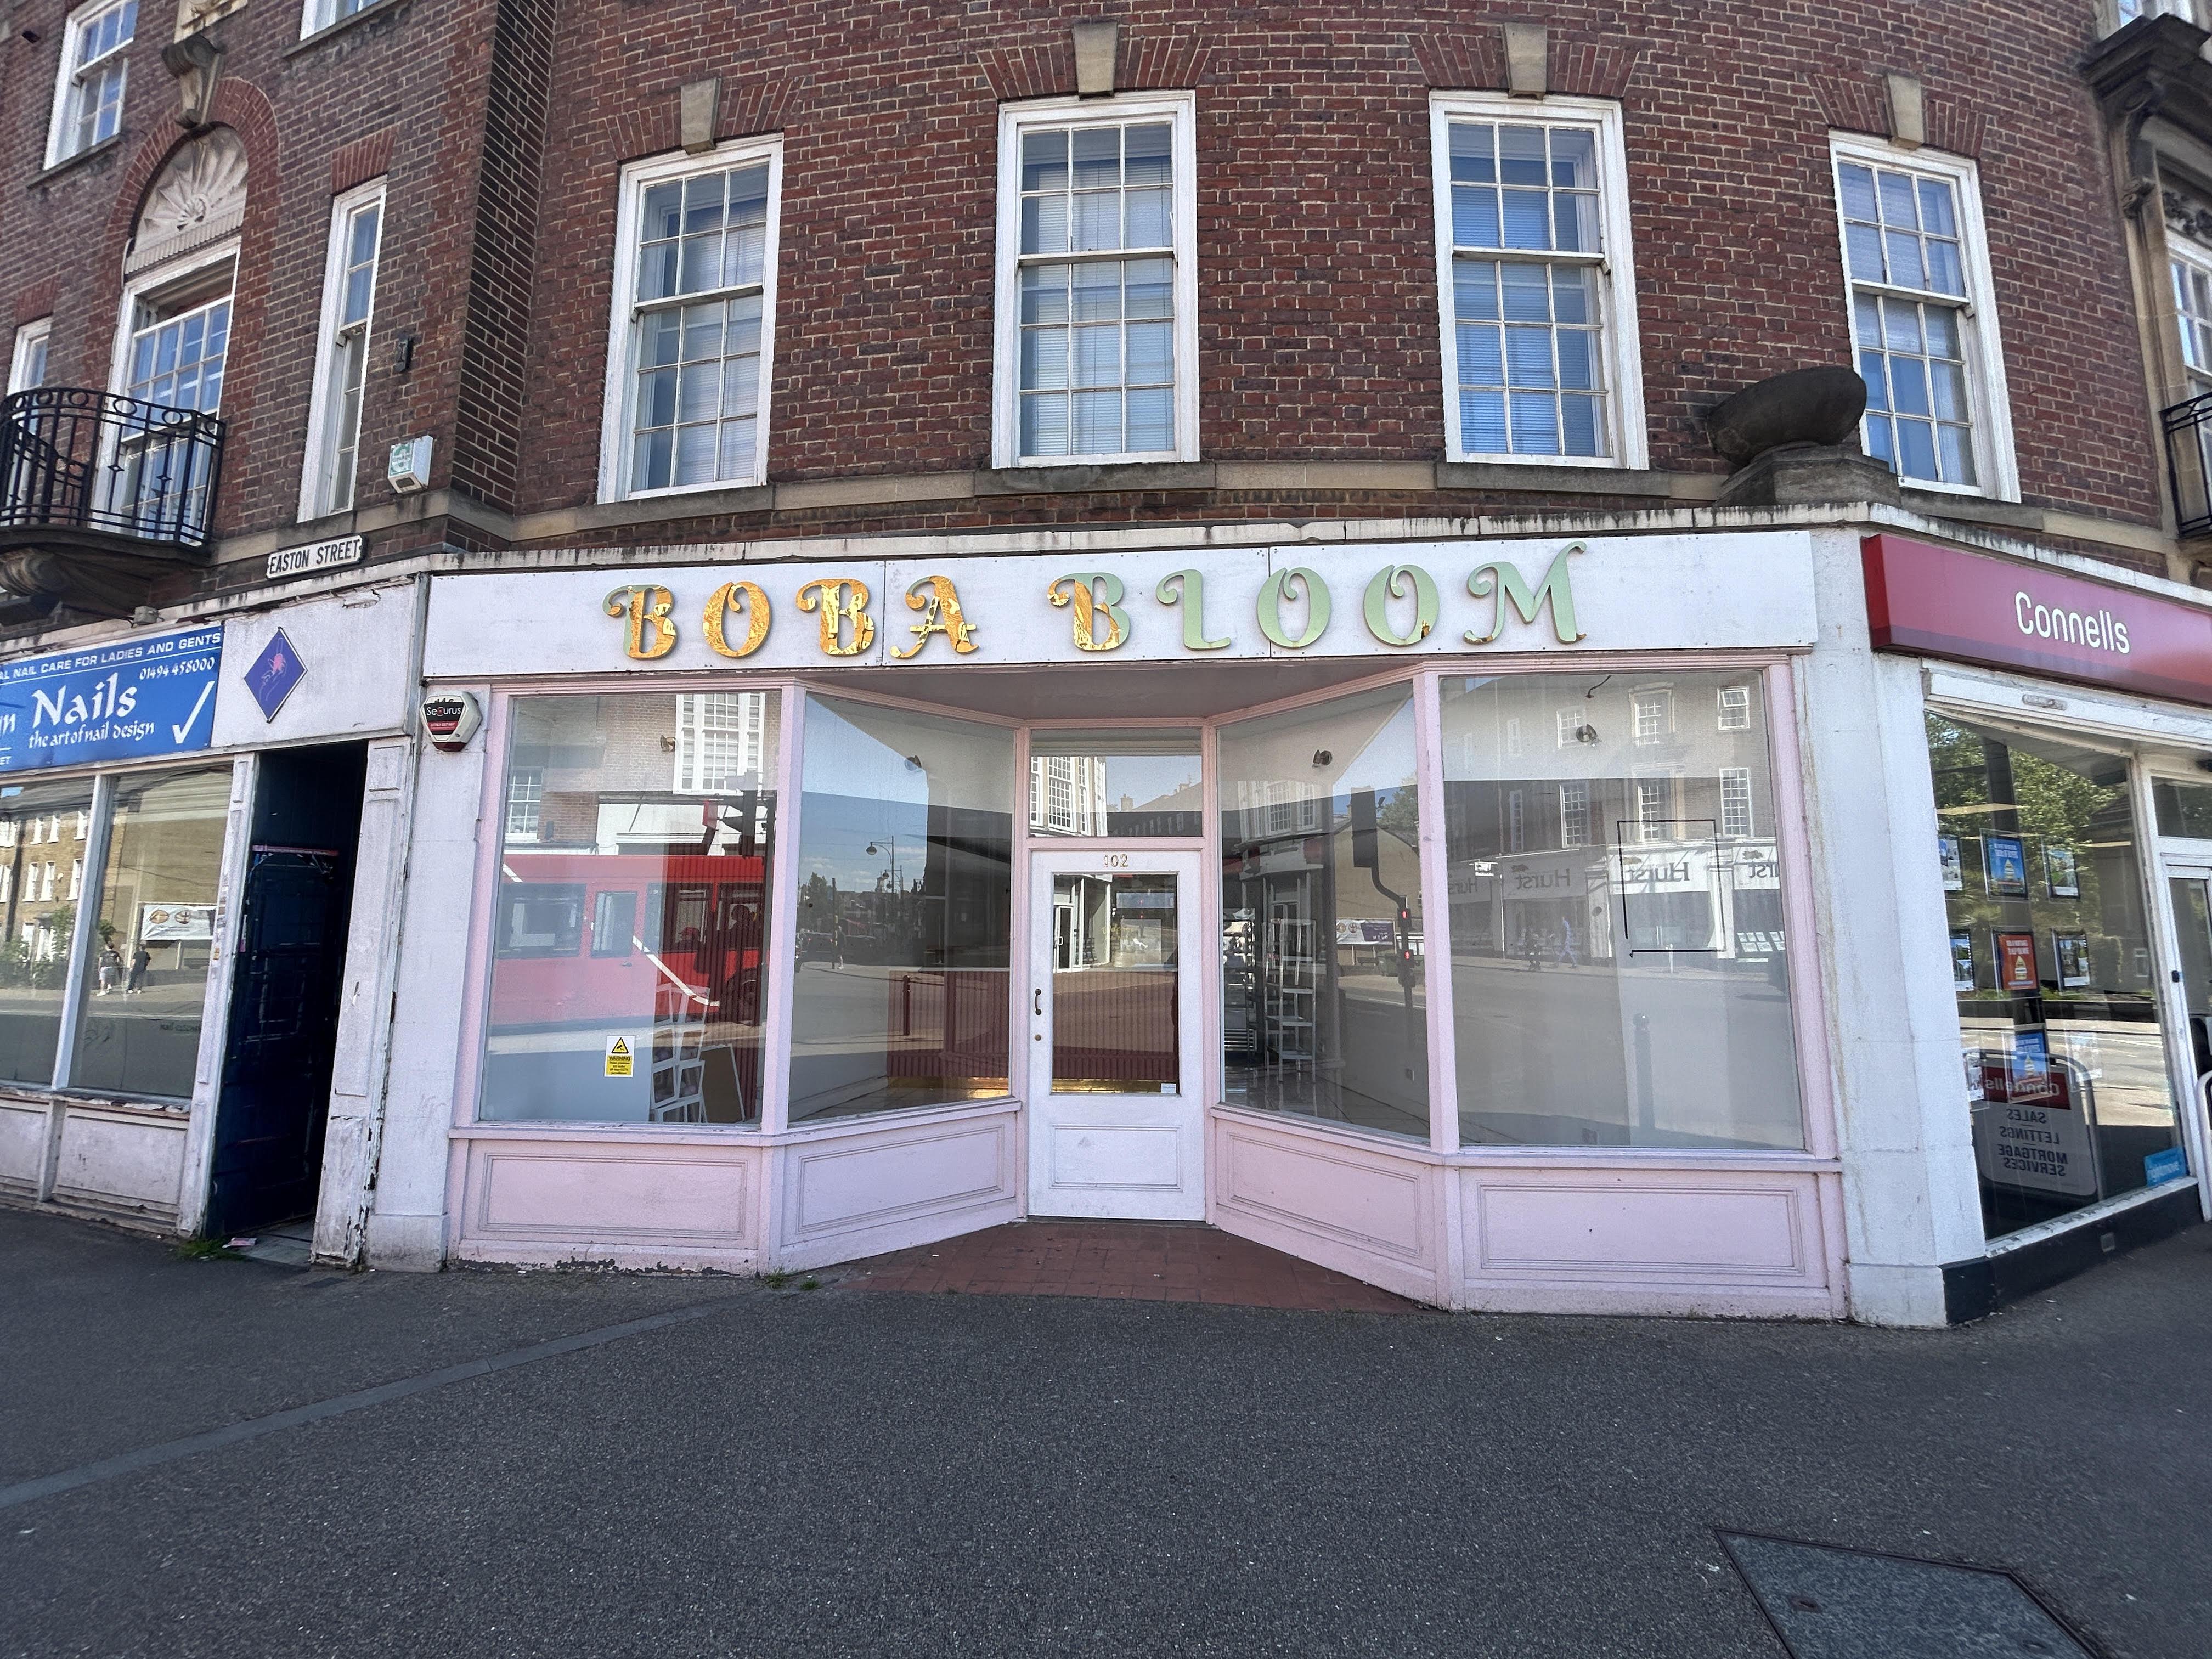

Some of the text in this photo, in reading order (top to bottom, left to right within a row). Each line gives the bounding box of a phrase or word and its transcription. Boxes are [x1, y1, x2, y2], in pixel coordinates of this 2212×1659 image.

[269, 539, 360, 574] EASTON STREET
[603, 540, 1587, 659] BOBA BLOOM
[2015, 591, 2130, 654] Connells
[13, 666, 37, 678] NAIL
[41, 659, 72, 673] CARE
[75, 656, 97, 667] FOR
[101, 645, 143, 663] LADIES
[147, 641, 173, 656] AND
[178, 633, 221, 650] GENTS
[32, 672, 137, 729] Nails
[29, 730, 49, 748] the
[85, 720, 109, 742] nail
[112, 720, 154, 741] design
[1104, 854, 1128, 867] 102
